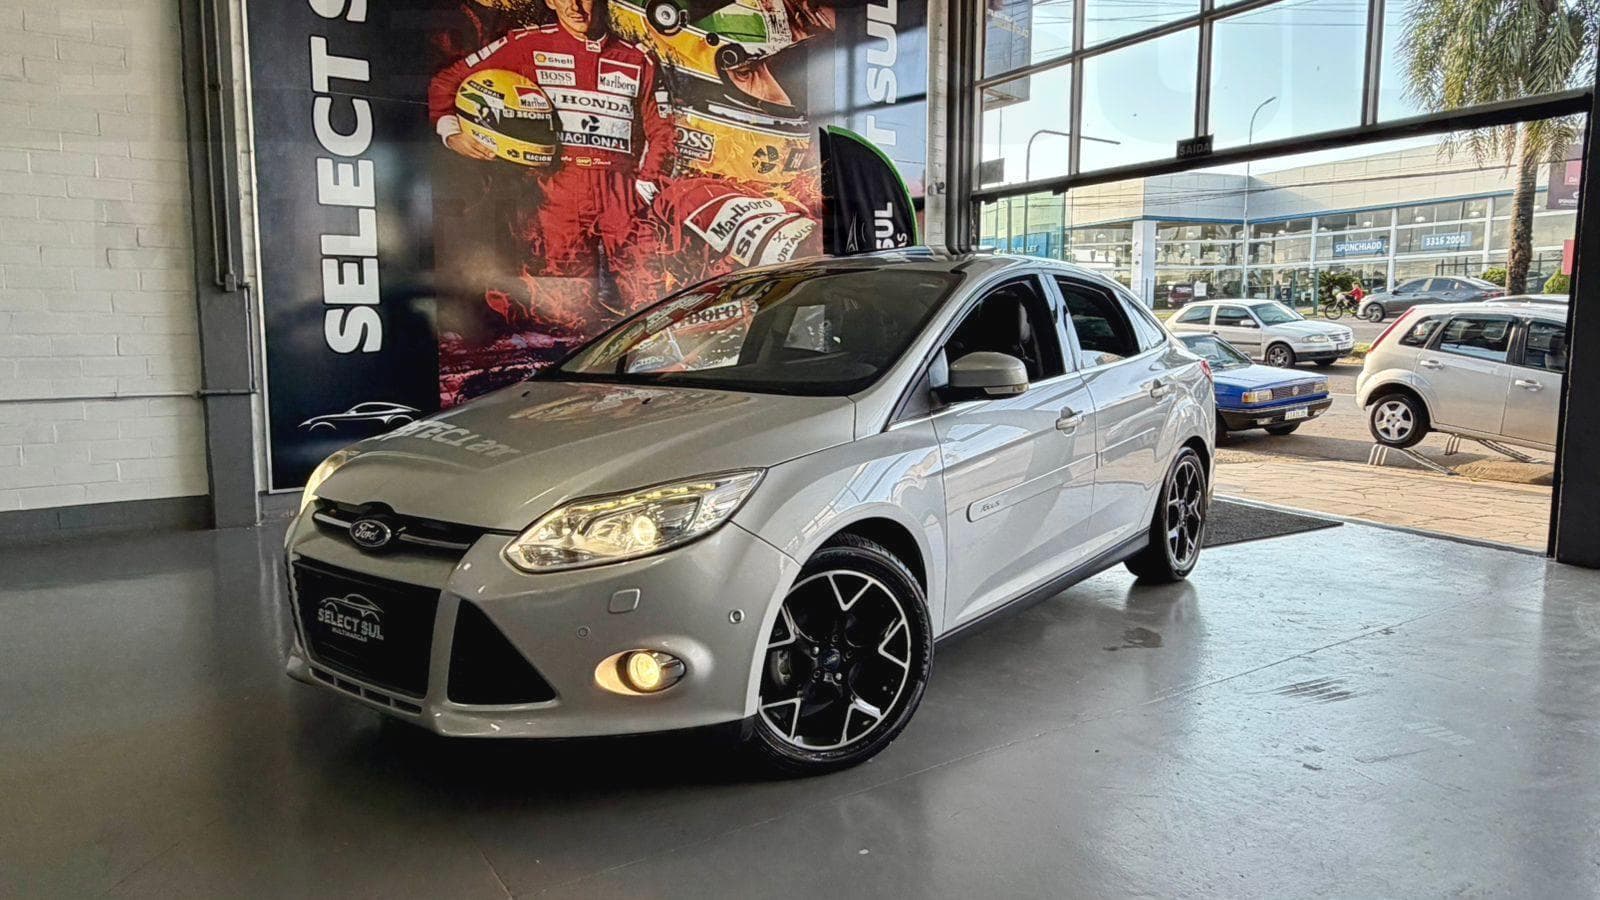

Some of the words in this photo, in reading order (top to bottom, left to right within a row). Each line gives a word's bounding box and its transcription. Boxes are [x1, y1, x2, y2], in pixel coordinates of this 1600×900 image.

[547, 56, 573, 65] Shell
[866, 0, 898, 105] SUL
[540, 71, 572, 81] BOSS
[560, 94, 631, 114] HONDA
[309, 36, 383, 354] SELECT
[710, 199, 773, 241] Marlboro
[1335, 241, 1382, 252] SPONCHIADO
[1425, 237, 1444, 246] 3316
[1446, 235, 1466, 244] 2000
[355, 522, 379, 541] Ford
[317, 607, 360, 632] SELECT
[360, 620, 384, 640] SUL
